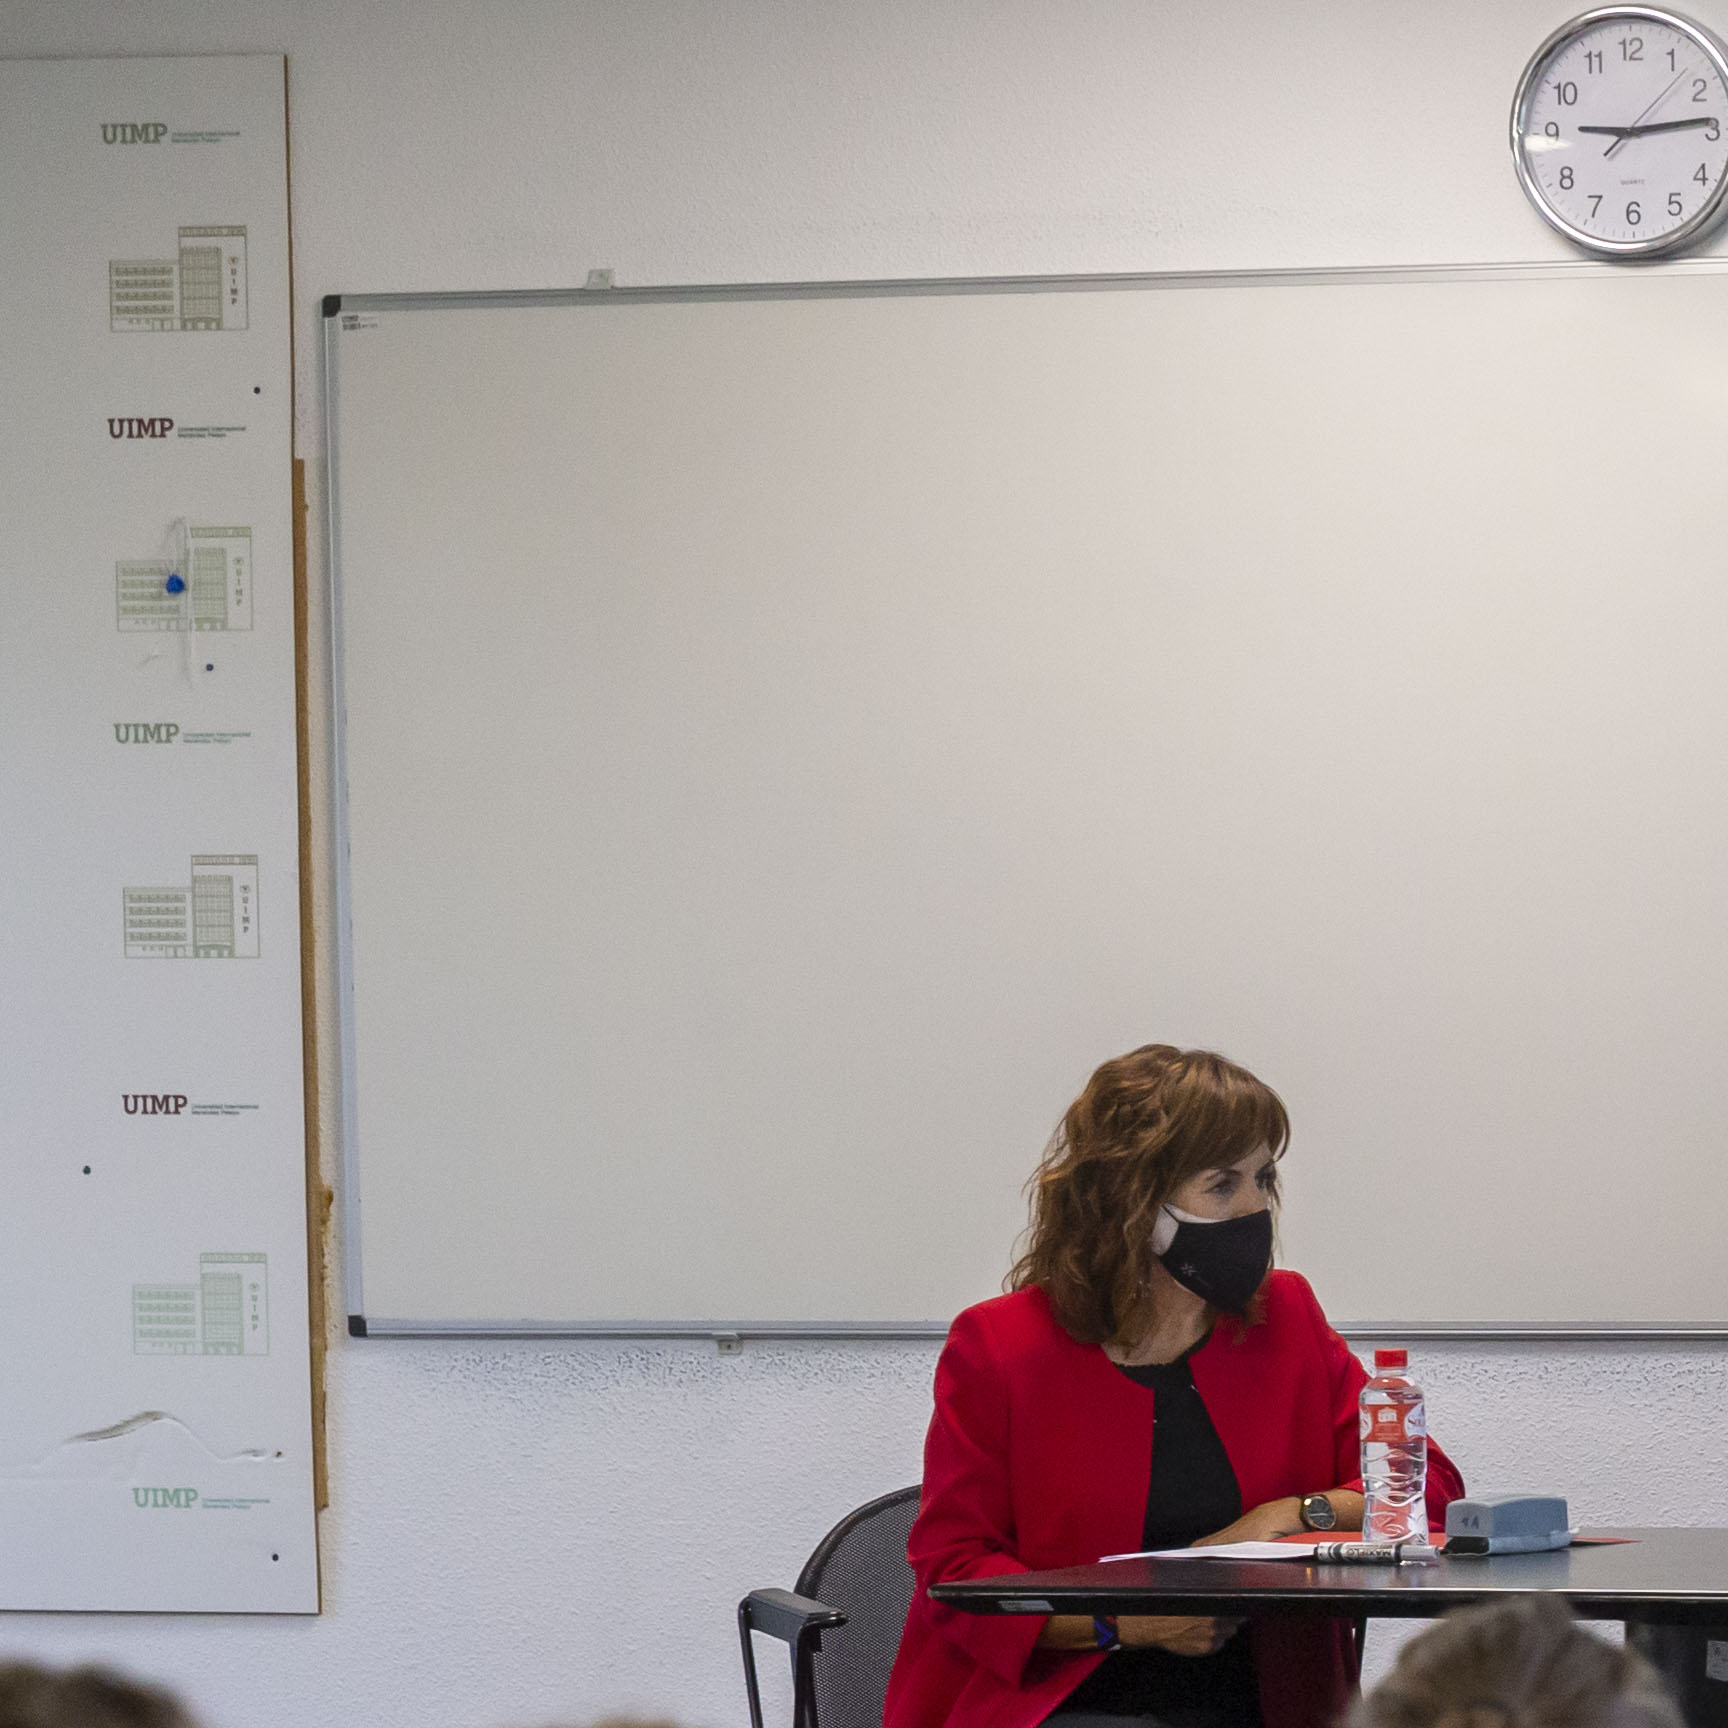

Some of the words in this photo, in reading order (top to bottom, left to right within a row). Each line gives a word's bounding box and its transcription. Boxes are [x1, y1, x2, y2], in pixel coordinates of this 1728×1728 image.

[1619, 37, 1643, 61] 12
[1667, 48, 1675, 71] 1
[1585, 51, 1602, 74] 11
[1554, 82, 1578, 106] 10
[1692, 79, 1707, 102] 2
[102, 124, 167, 144] UIMP
[1545, 122, 1560, 145] 9
[1704, 118, 1720, 141] 3
[1559, 166, 1574, 190] 8
[1694, 163, 1709, 186] 4
[1588, 194, 1603, 218] 7
[1626, 202, 1641, 225] 6
[1668, 193, 1683, 216] 5
[108, 418, 173, 438] UIMP
[115, 724, 178, 744] UIMP
[123, 1095, 187, 1114] UIMP
[133, 1488, 197, 1508] UIMP
